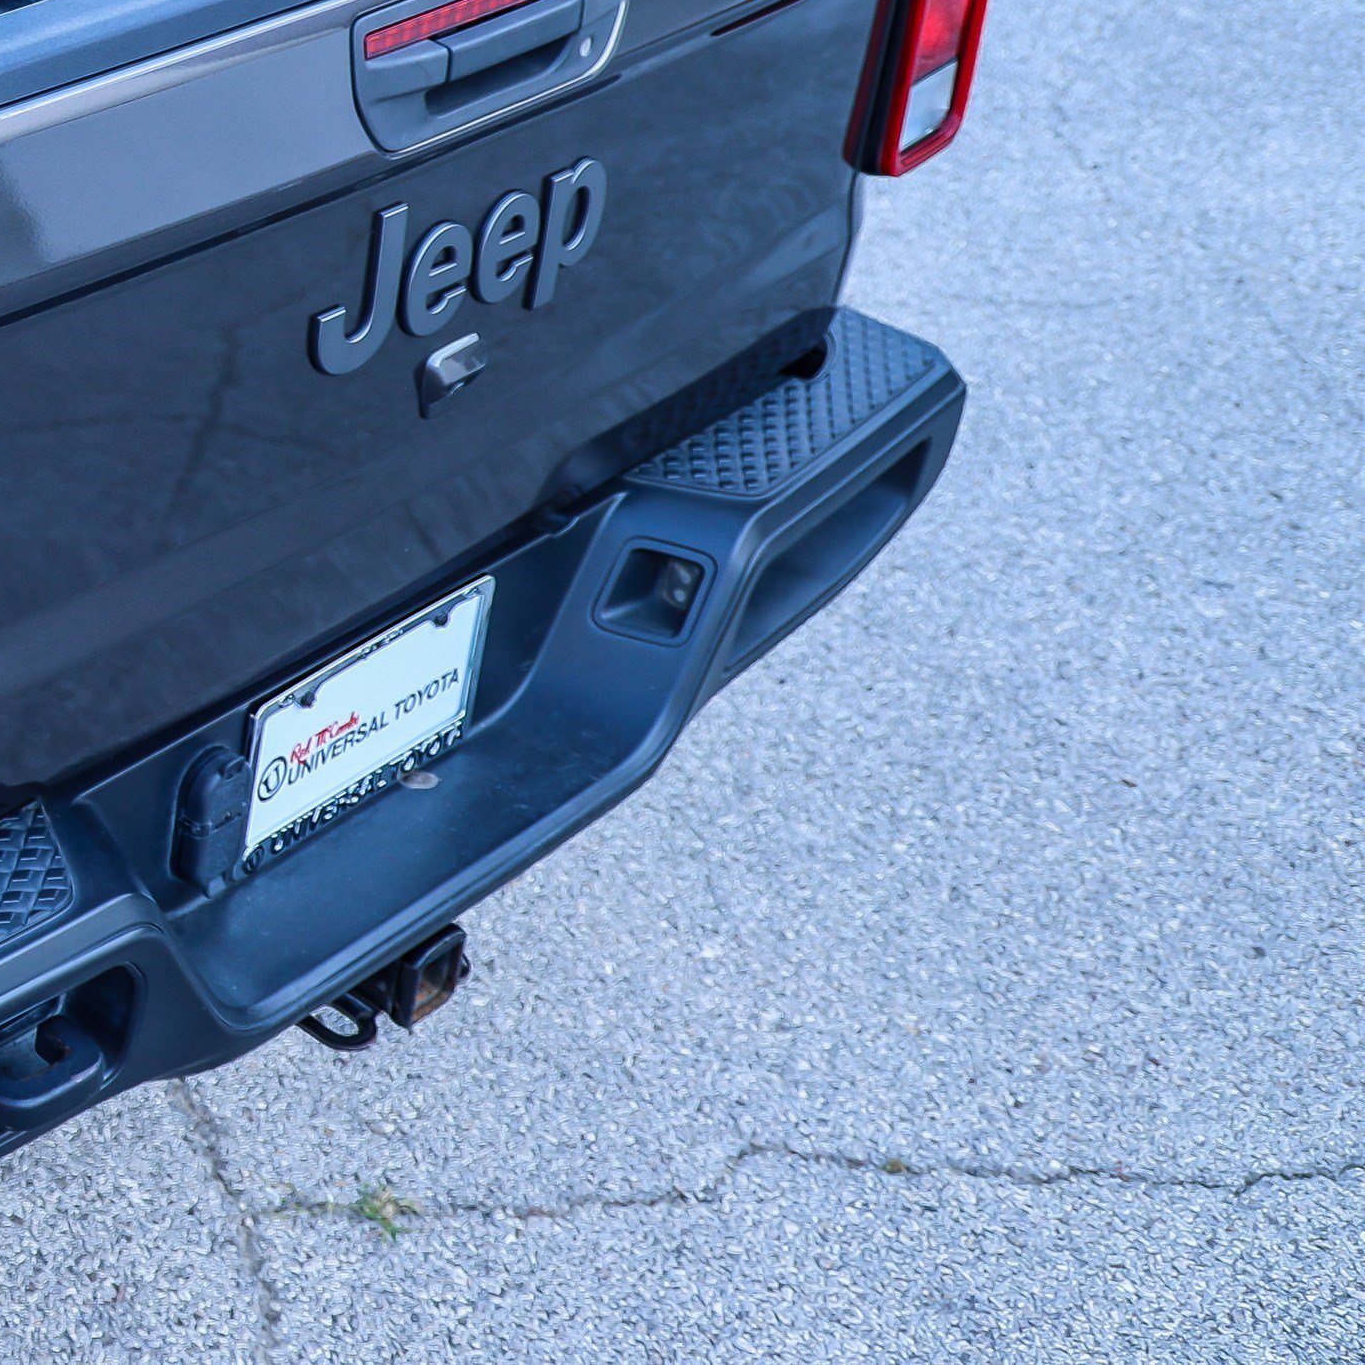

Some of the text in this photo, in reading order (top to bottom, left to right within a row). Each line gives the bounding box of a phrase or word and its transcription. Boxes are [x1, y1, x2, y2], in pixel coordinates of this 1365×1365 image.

[308, 156, 607, 375] Jeep
[270, 769, 387, 855] UNIVERSAL
[389, 721, 463, 778] TOYOTA
[288, 712, 389, 785] UNIVERSAL
[394, 668, 459, 720] TOYOTA
